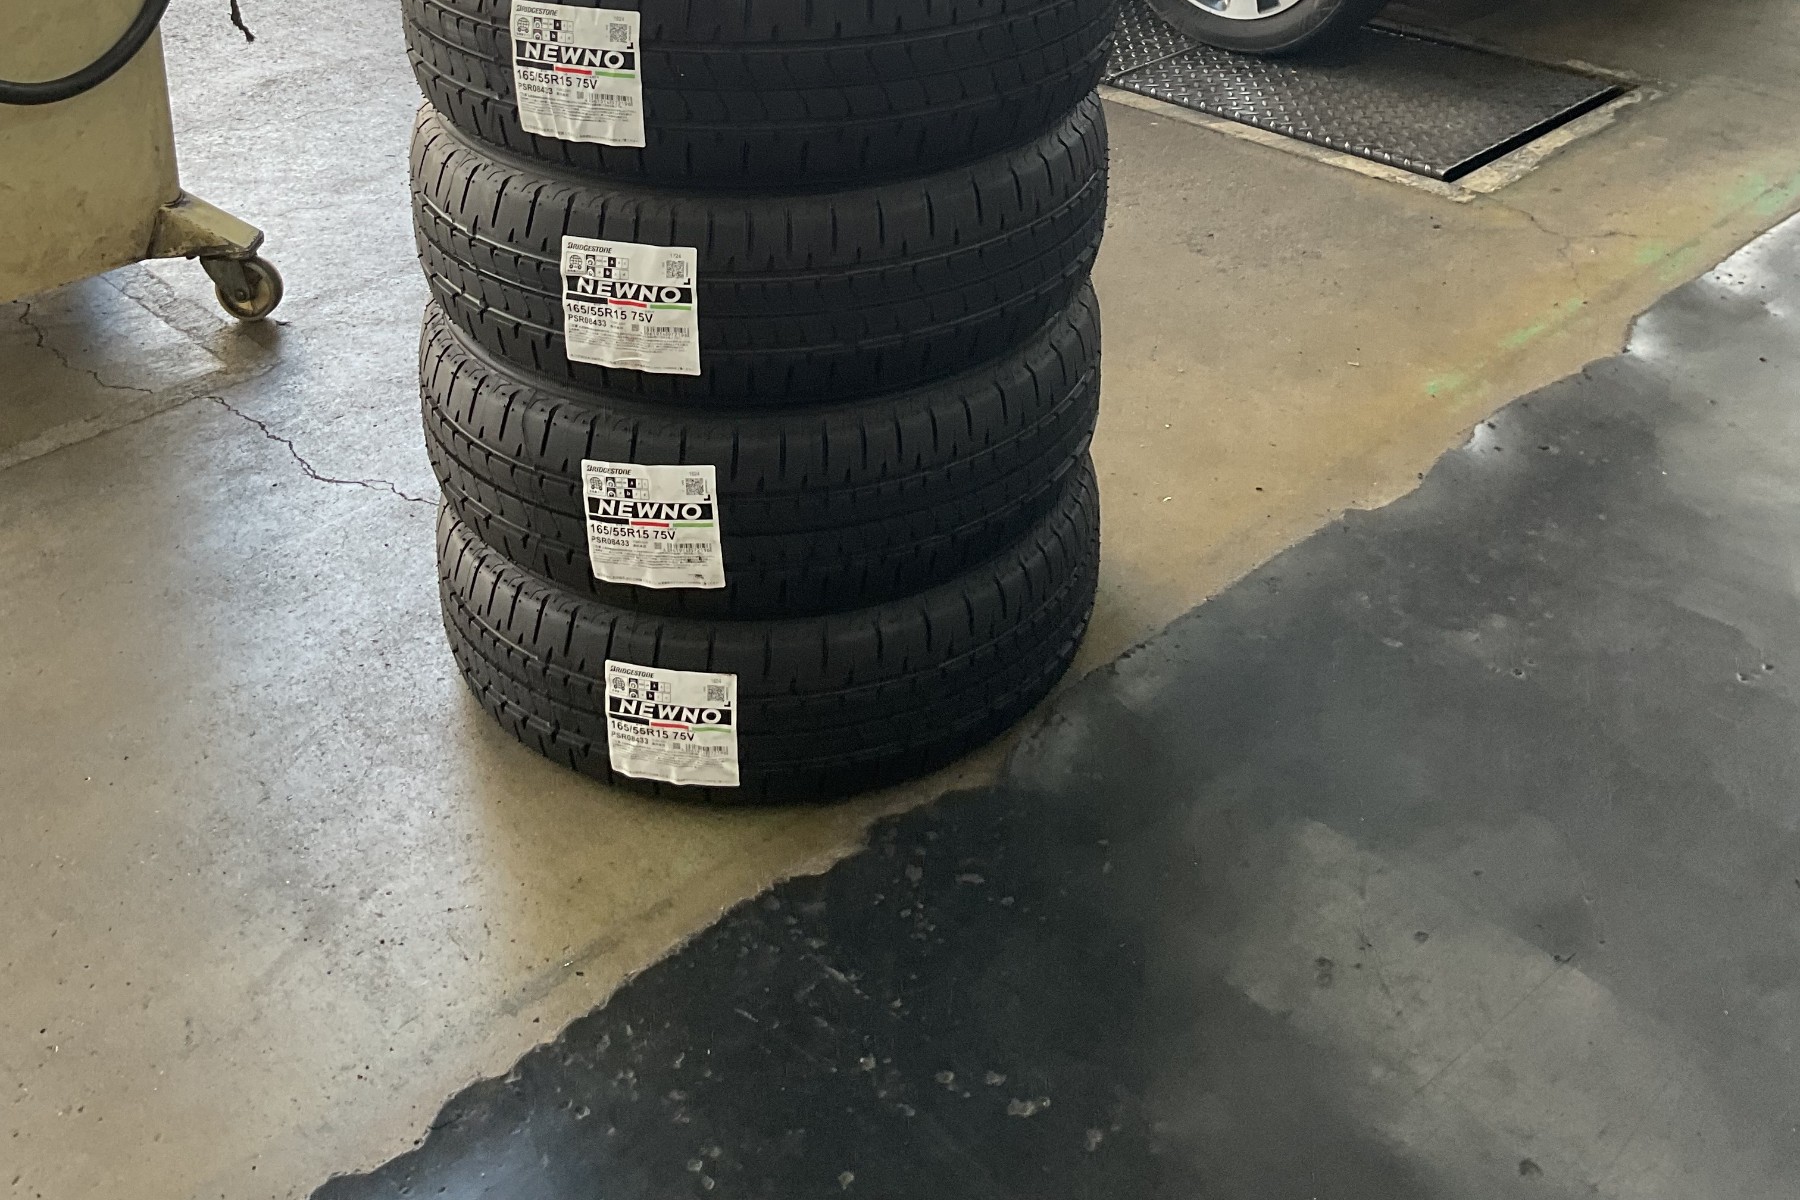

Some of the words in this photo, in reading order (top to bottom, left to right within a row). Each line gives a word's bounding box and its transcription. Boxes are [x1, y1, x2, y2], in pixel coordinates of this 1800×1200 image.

[516, 4, 558, 17] BRIDGESTONE
[524, 41, 625, 69] NEWNO
[517, 69, 572, 87] 165/55R15
[576, 77, 597, 90] 75V
[567, 242, 612, 254] BRIDGESTONE
[576, 276, 682, 303] NEWNO
[566, 302, 627, 320] 165/55R15
[631, 310, 653, 323] 75V
[586, 464, 632, 476] BRIDGESTONE
[598, 499, 702, 520] NEWNO
[590, 524, 649, 539] 165/55R15
[654, 530, 676, 541] 75V
[609, 664, 654, 679] BRIDGESTONE
[618, 698, 722, 724] NEWNO
[611, 720, 669, 739] 165/55R15
[673, 730, 694, 742] 75V
